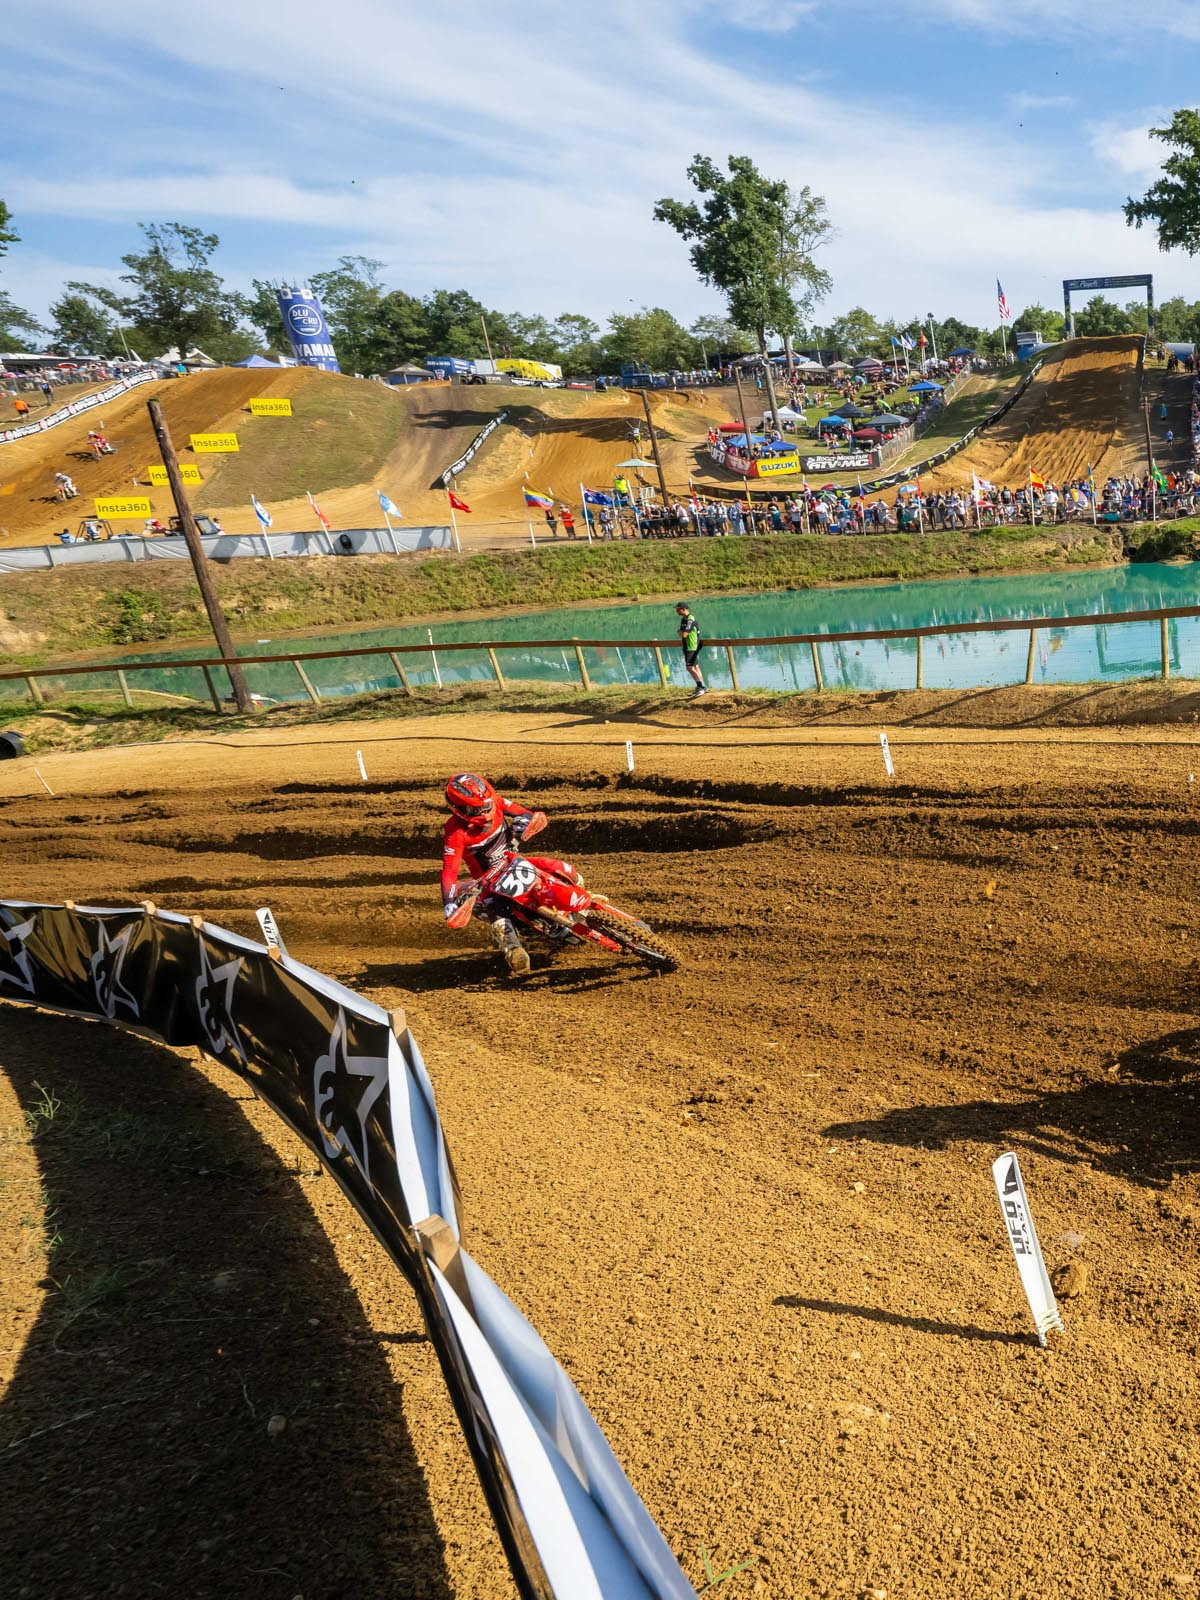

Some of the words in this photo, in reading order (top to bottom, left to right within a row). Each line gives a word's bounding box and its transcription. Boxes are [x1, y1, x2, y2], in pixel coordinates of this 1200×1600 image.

[252, 404, 289, 412] Insta360
[193, 439, 236, 447] Insta360
[761, 462, 798, 472] SUZUKI
[98, 503, 148, 513] Insta360
[502, 860, 537, 898] 30
[1002, 1200, 1027, 1255] UFO
